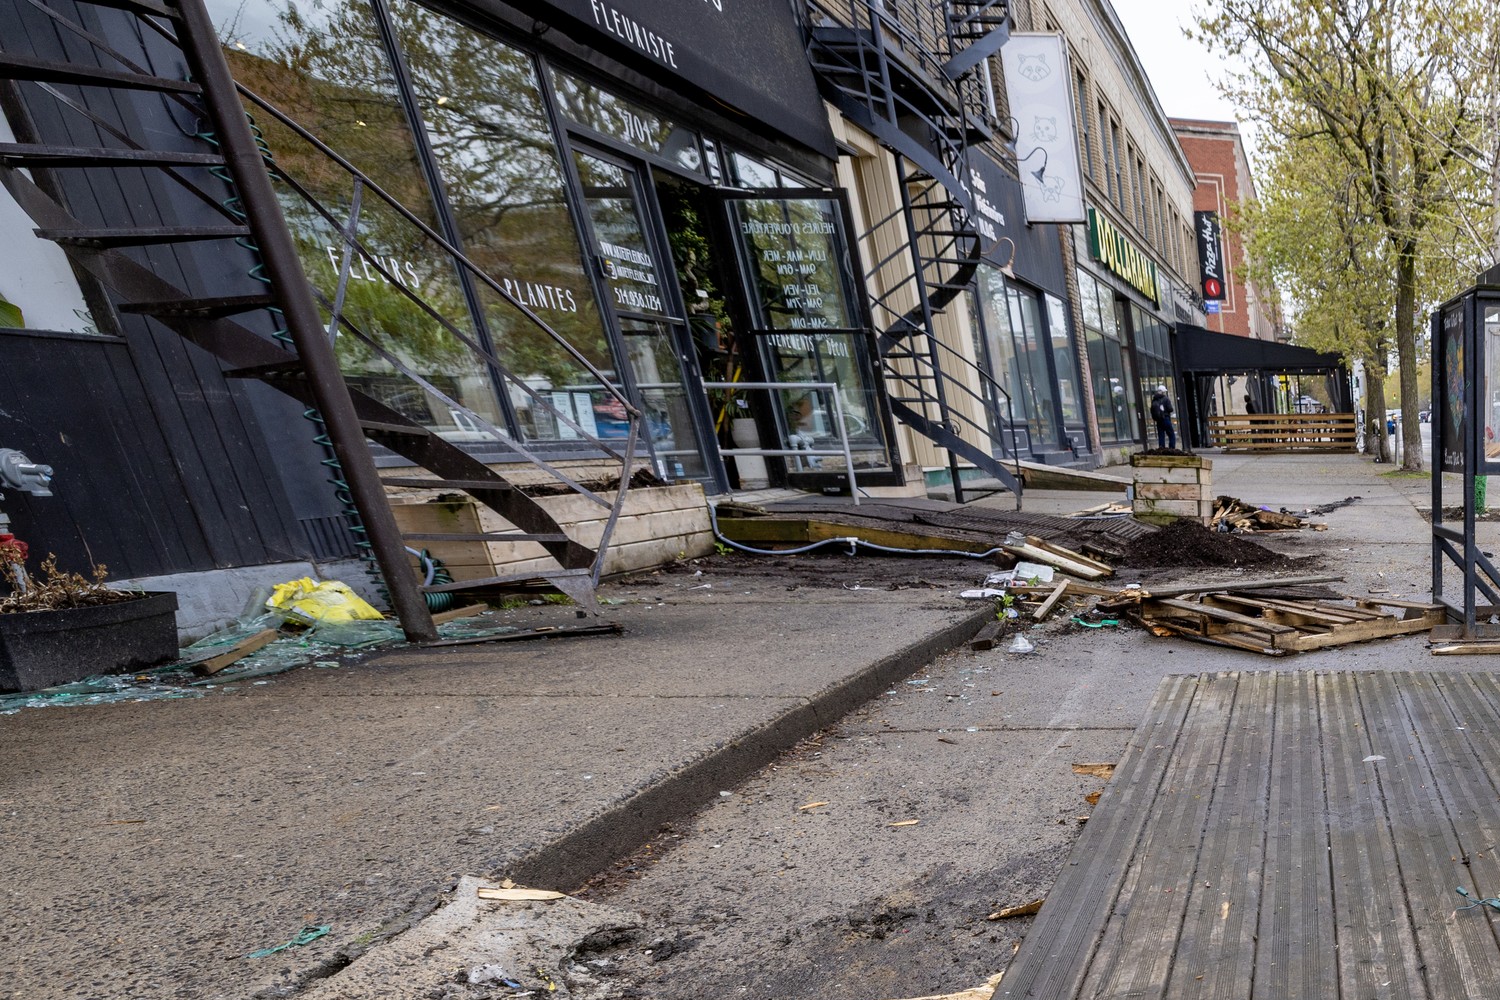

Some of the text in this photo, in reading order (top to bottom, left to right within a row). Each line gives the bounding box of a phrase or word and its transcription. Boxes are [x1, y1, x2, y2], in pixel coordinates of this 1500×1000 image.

[591, 0, 678, 69] FLEURISTE
[1201, 214, 1214, 242] Hut
[326, 246, 420, 289] FLEURS
[1095, 209, 1157, 303] DOLLARAMA
[1204, 242, 1219, 278] Pizza
[503, 277, 577, 313] PLANTES
